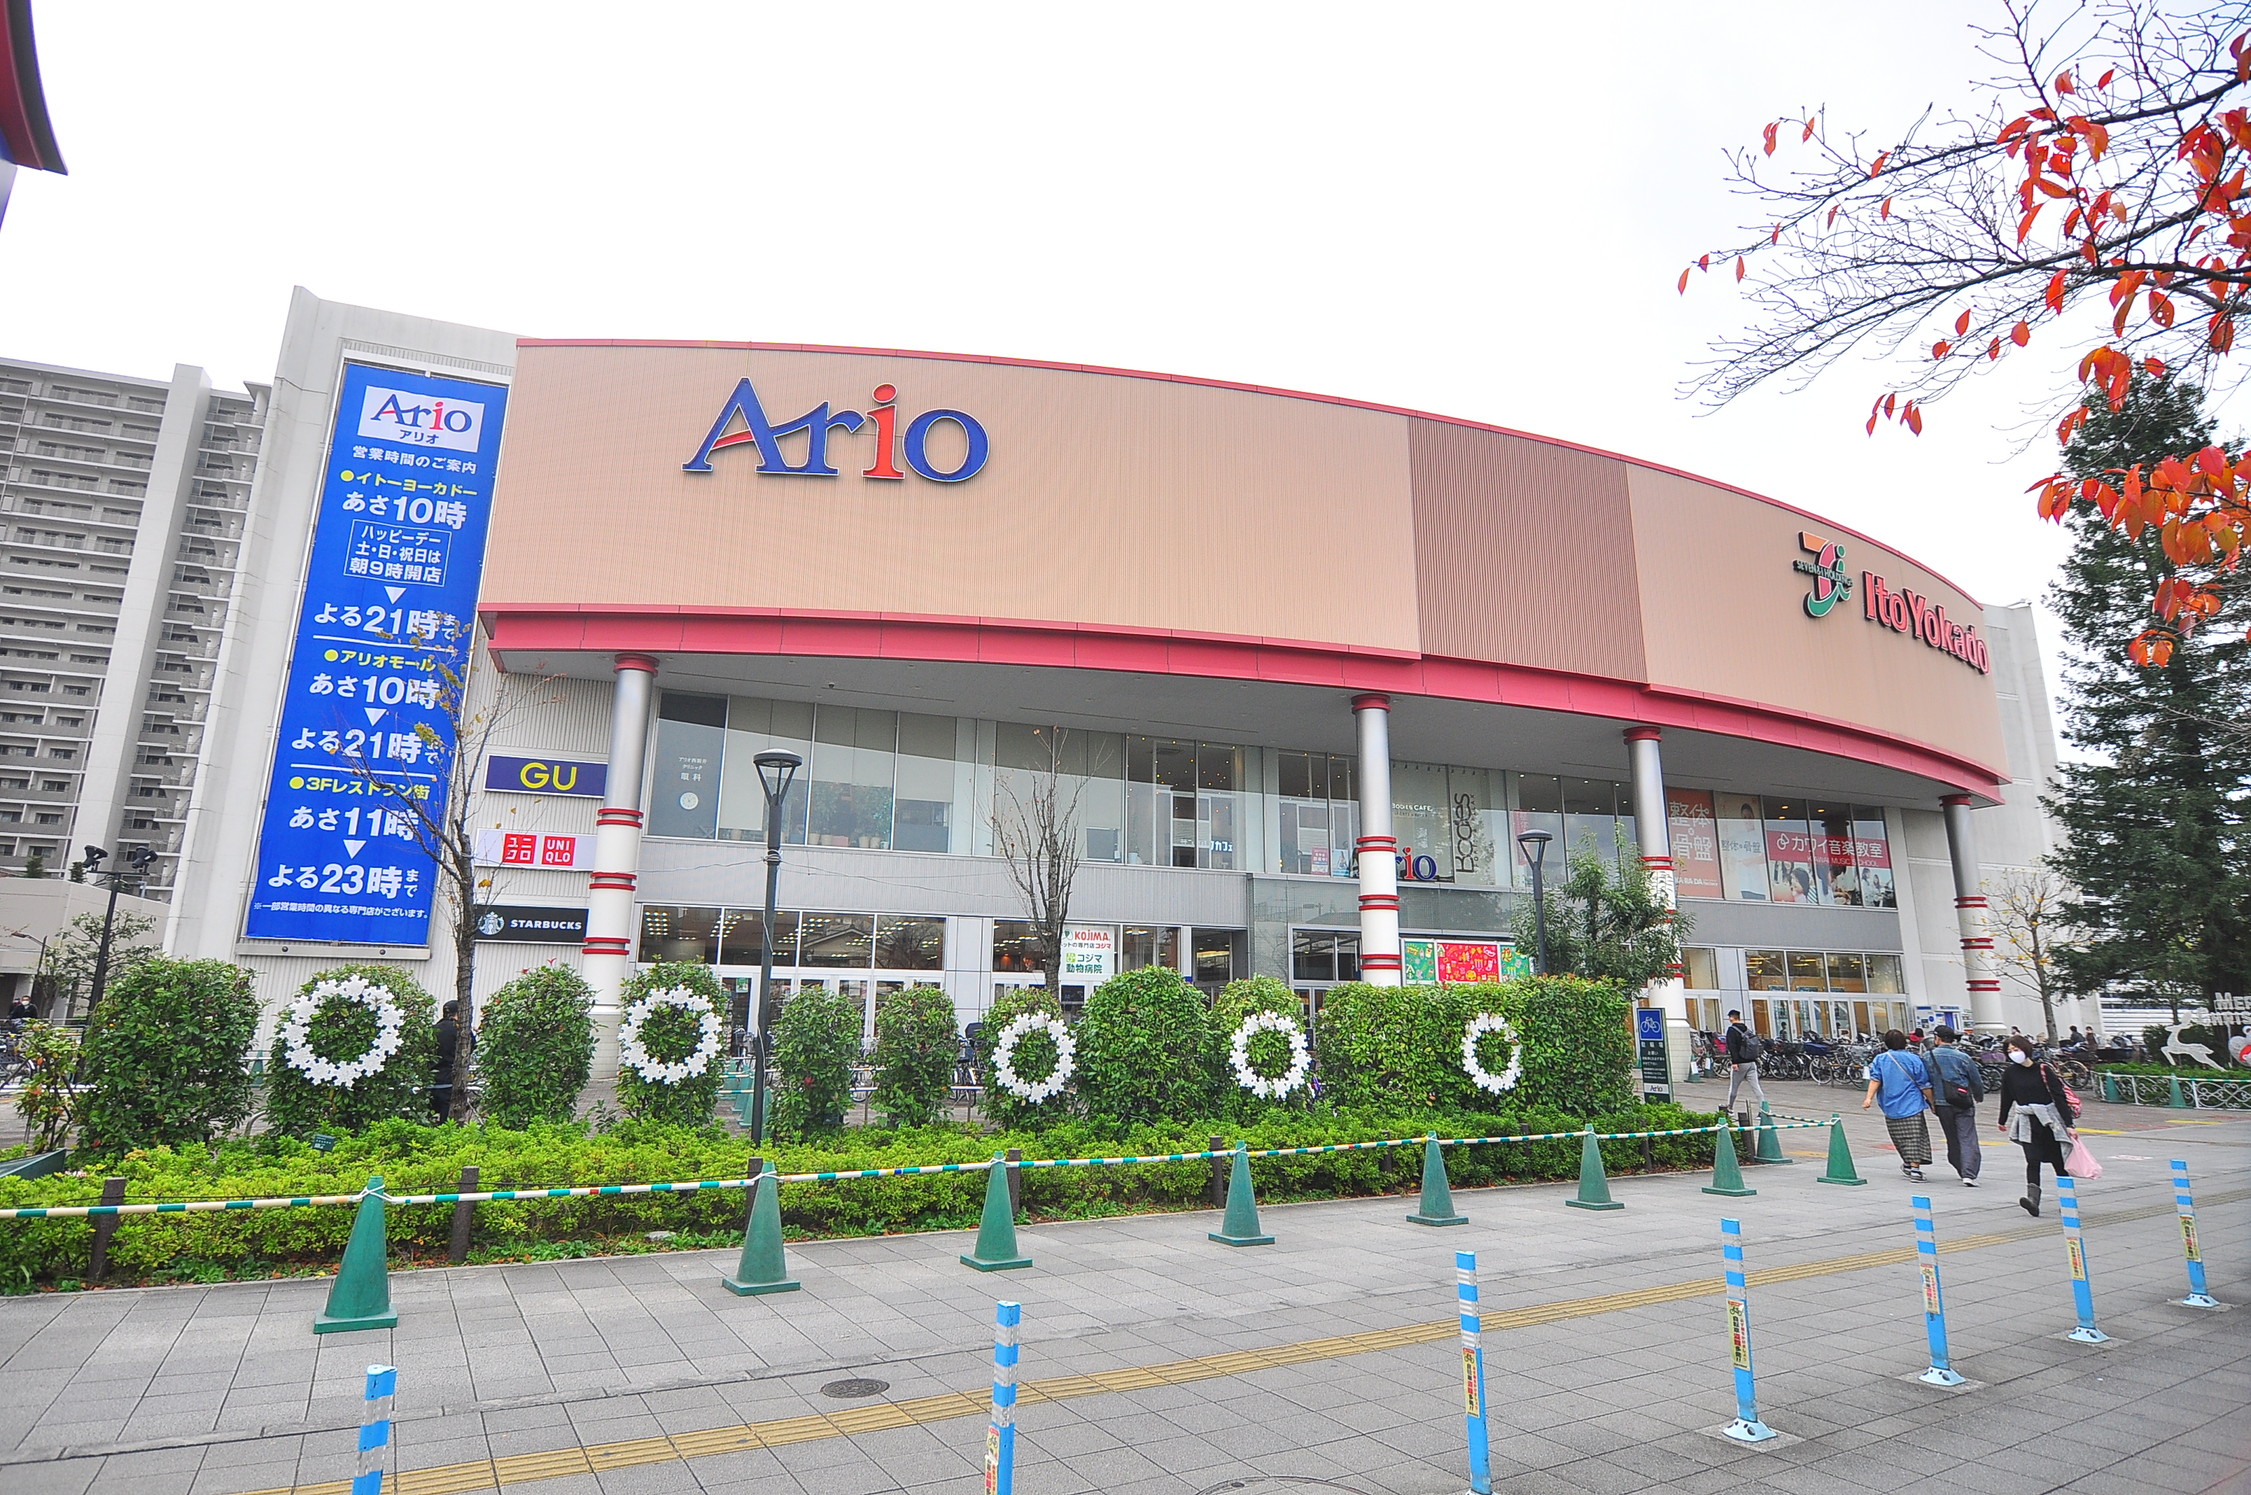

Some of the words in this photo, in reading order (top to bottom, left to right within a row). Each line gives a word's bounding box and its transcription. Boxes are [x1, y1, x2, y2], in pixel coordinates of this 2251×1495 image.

[370, 393, 472, 433] Ario
[400, 429, 439, 444] アリオ
[681, 376, 990, 483] Ario
[352, 445, 476, 474] 営業時間のご案内
[356, 472, 477, 496] イトーヨーカドー
[342, 491, 467, 530] あさ10時
[361, 525, 441, 546] ハッピーデー
[355, 541, 441, 564] 土・日・祝日は
[349, 557, 442, 583] 朝9時開店
[1863, 571, 1989, 675] ItoYokado
[341, 650, 436, 672] アリオモール
[309, 673, 440, 709] あさ10時
[520, 762, 578, 791] GU
[289, 806, 419, 841] あさ11時
[1669, 801, 1711, 828] 整体
[507, 837, 532, 849] ユニ
[546, 839, 570, 851] UNI
[1673, 833, 1713, 861] 骨盤
[1791, 837, 1884, 858] カワイ音楽教室
[505, 850, 531, 861] クロ
[545, 851, 571, 863] QLO
[268, 864, 419, 899] よる23時まで
[510, 919, 582, 930] STARBUCKS
[1066, 963, 1102, 974] 動物病院
[1077, 953, 1102, 962] コジマ
